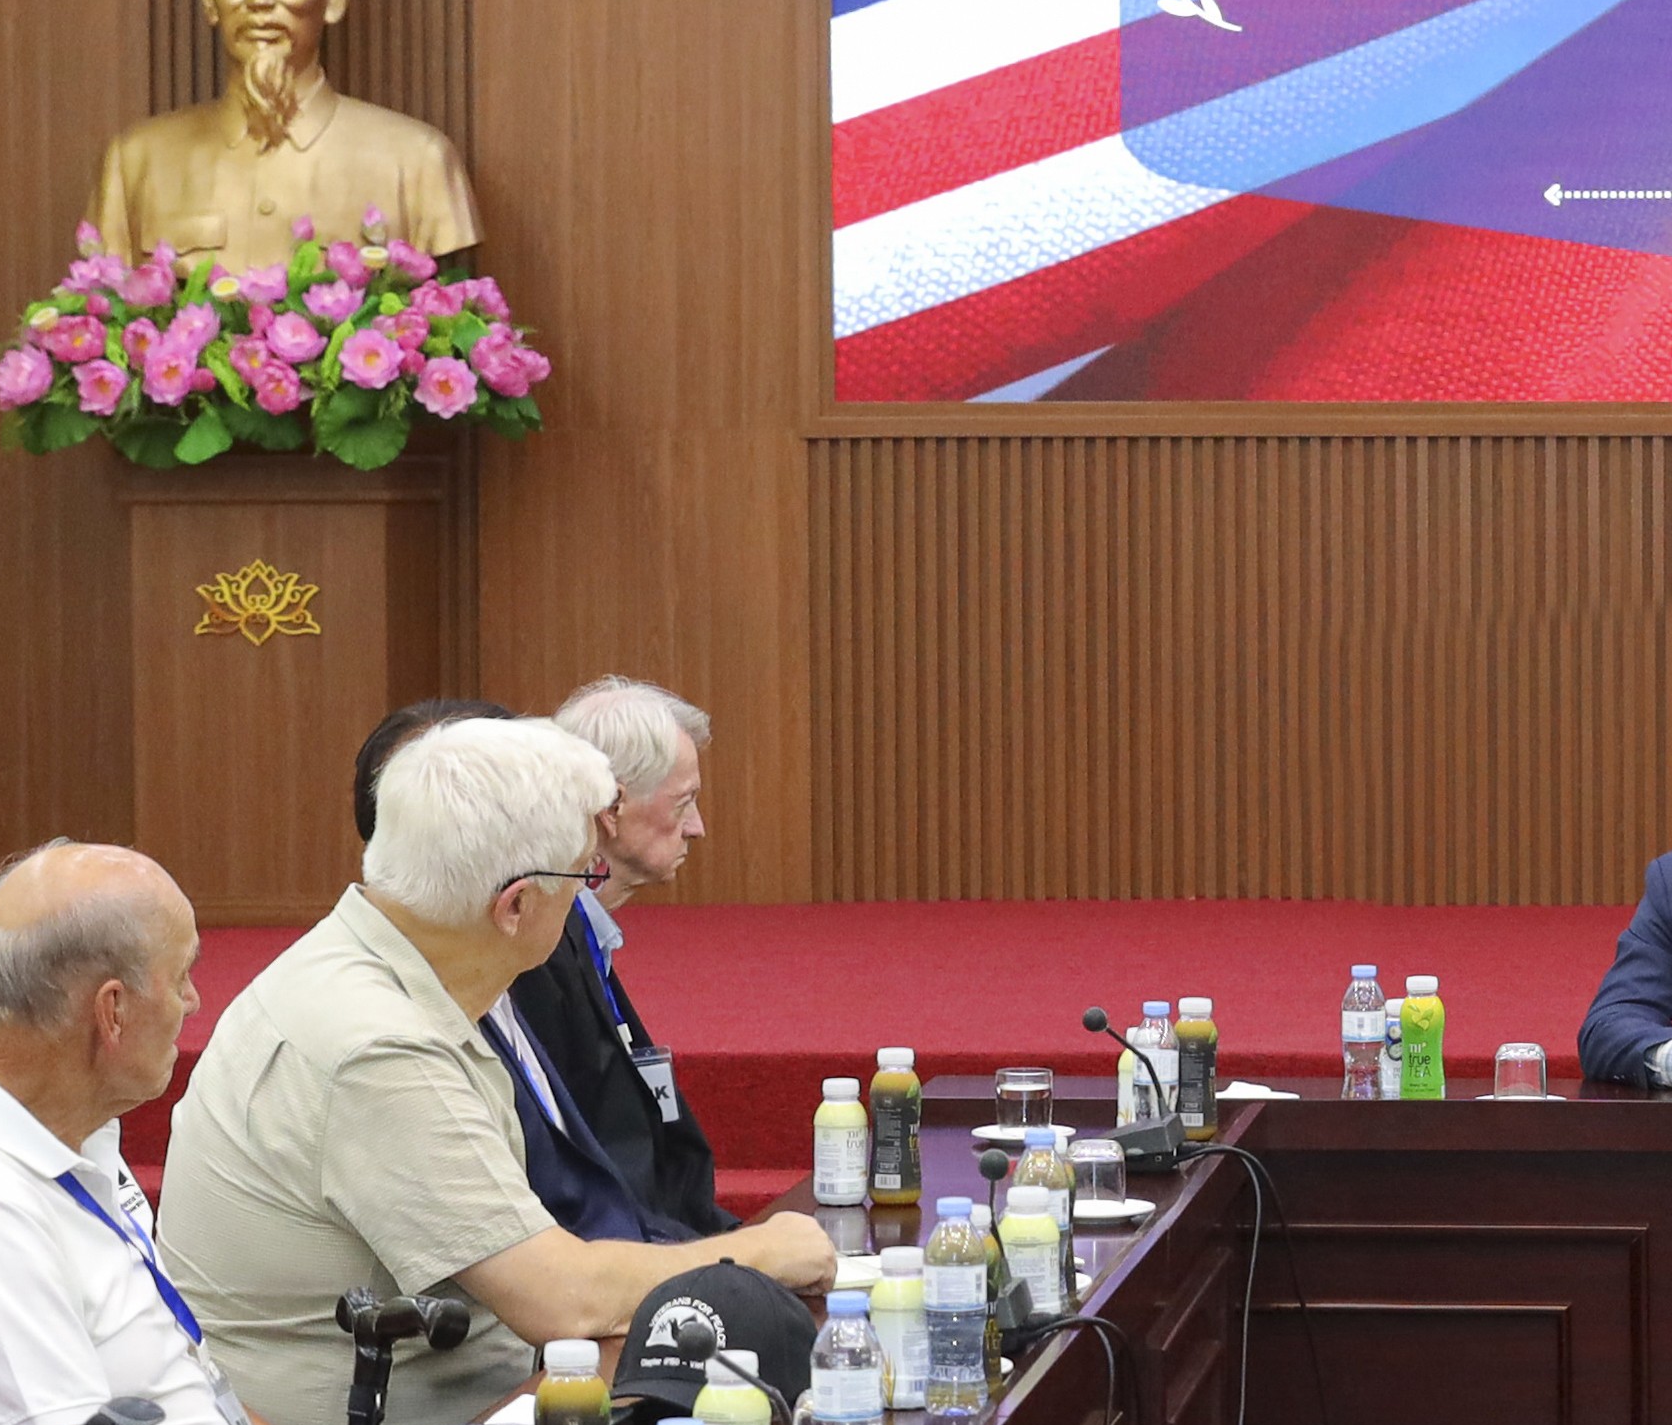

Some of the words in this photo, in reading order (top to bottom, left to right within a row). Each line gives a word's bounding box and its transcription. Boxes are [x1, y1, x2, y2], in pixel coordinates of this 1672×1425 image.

[1409, 1053, 1431, 1065] true
[1408, 1065, 1432, 1077] TEA
[692, 1299, 713, 1315] FOR
